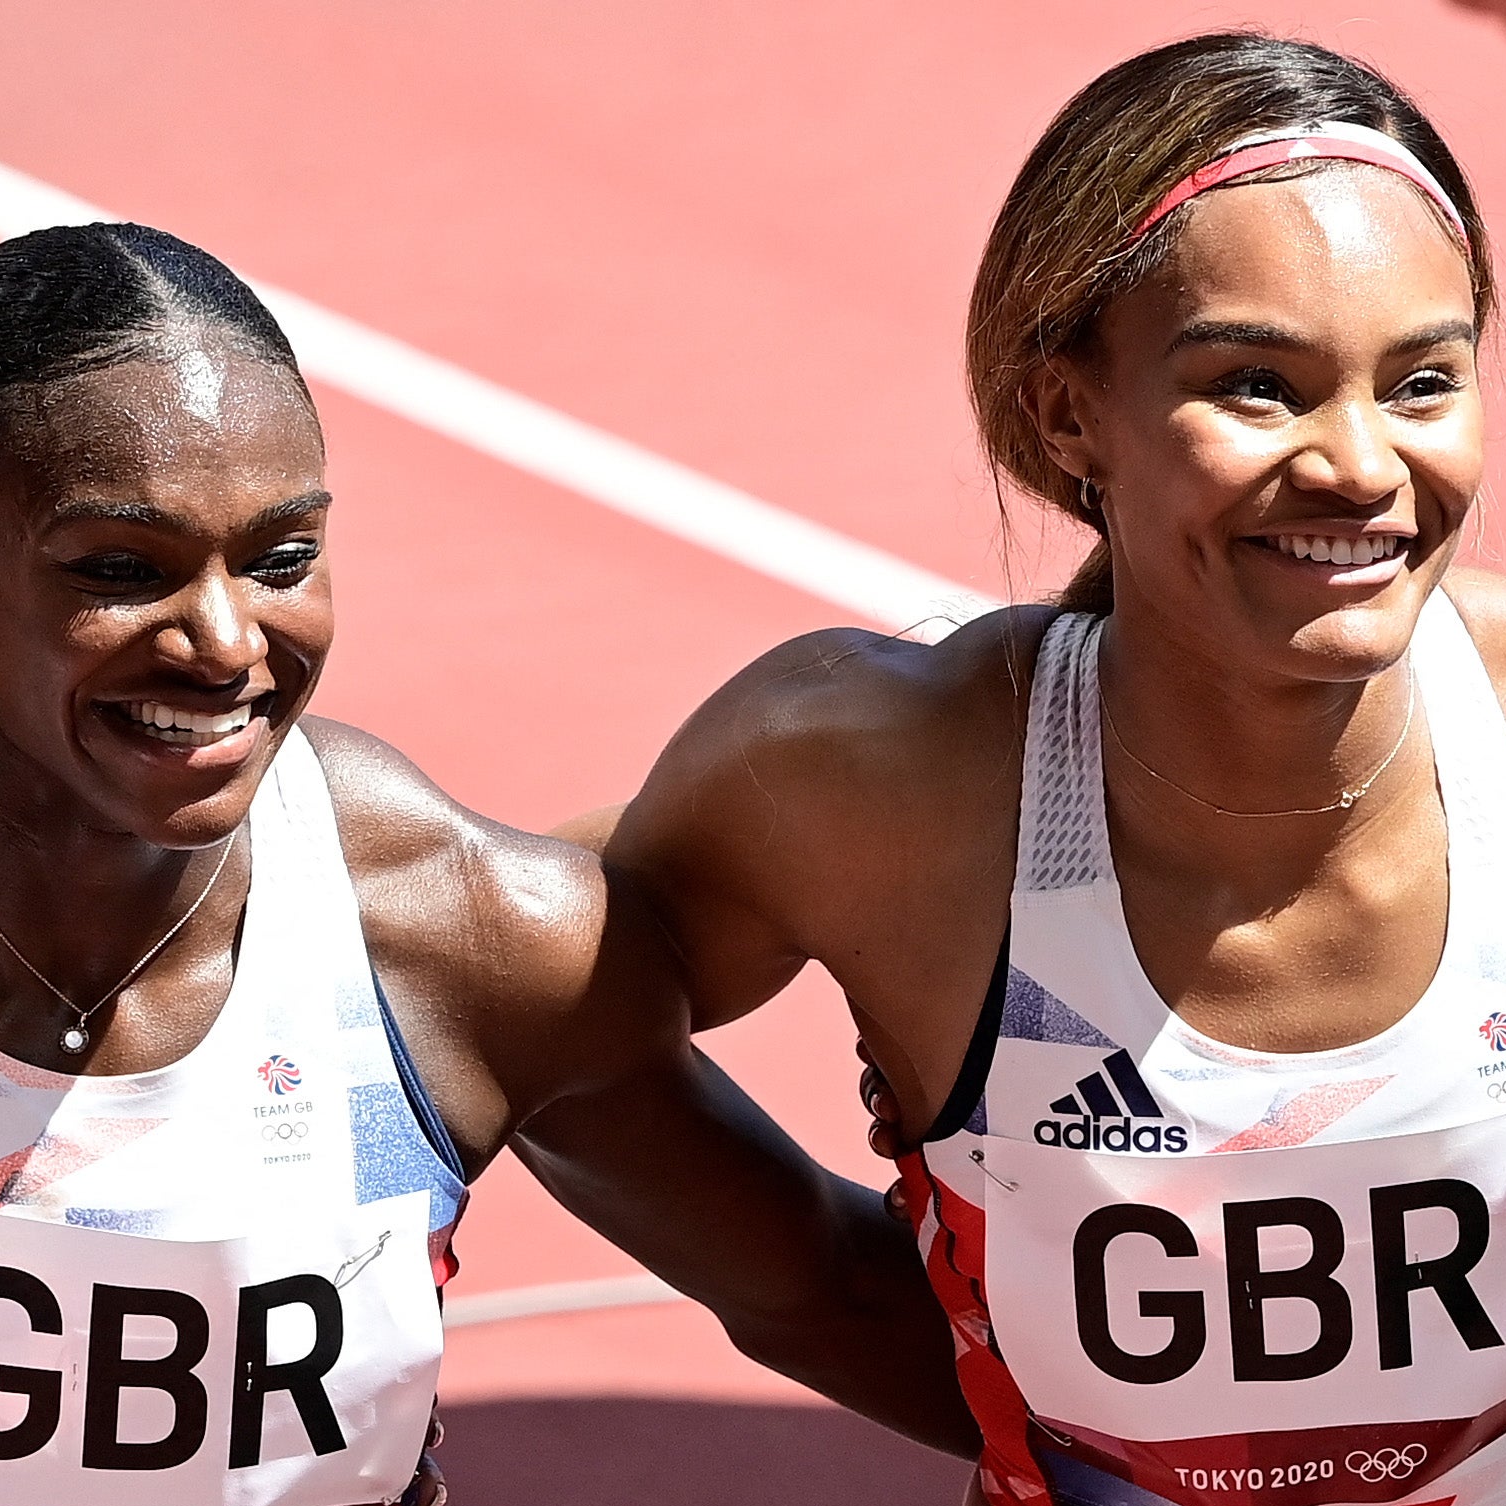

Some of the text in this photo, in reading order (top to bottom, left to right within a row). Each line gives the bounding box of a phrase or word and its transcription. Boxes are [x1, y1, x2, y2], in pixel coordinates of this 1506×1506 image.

[253, 1101, 313, 1118] TEAM GB
[1033, 1115, 1188, 1153] adidas
[1072, 1178, 1505, 1385] GBR
[1174, 1458, 1335, 1491] TOKYO 2020
